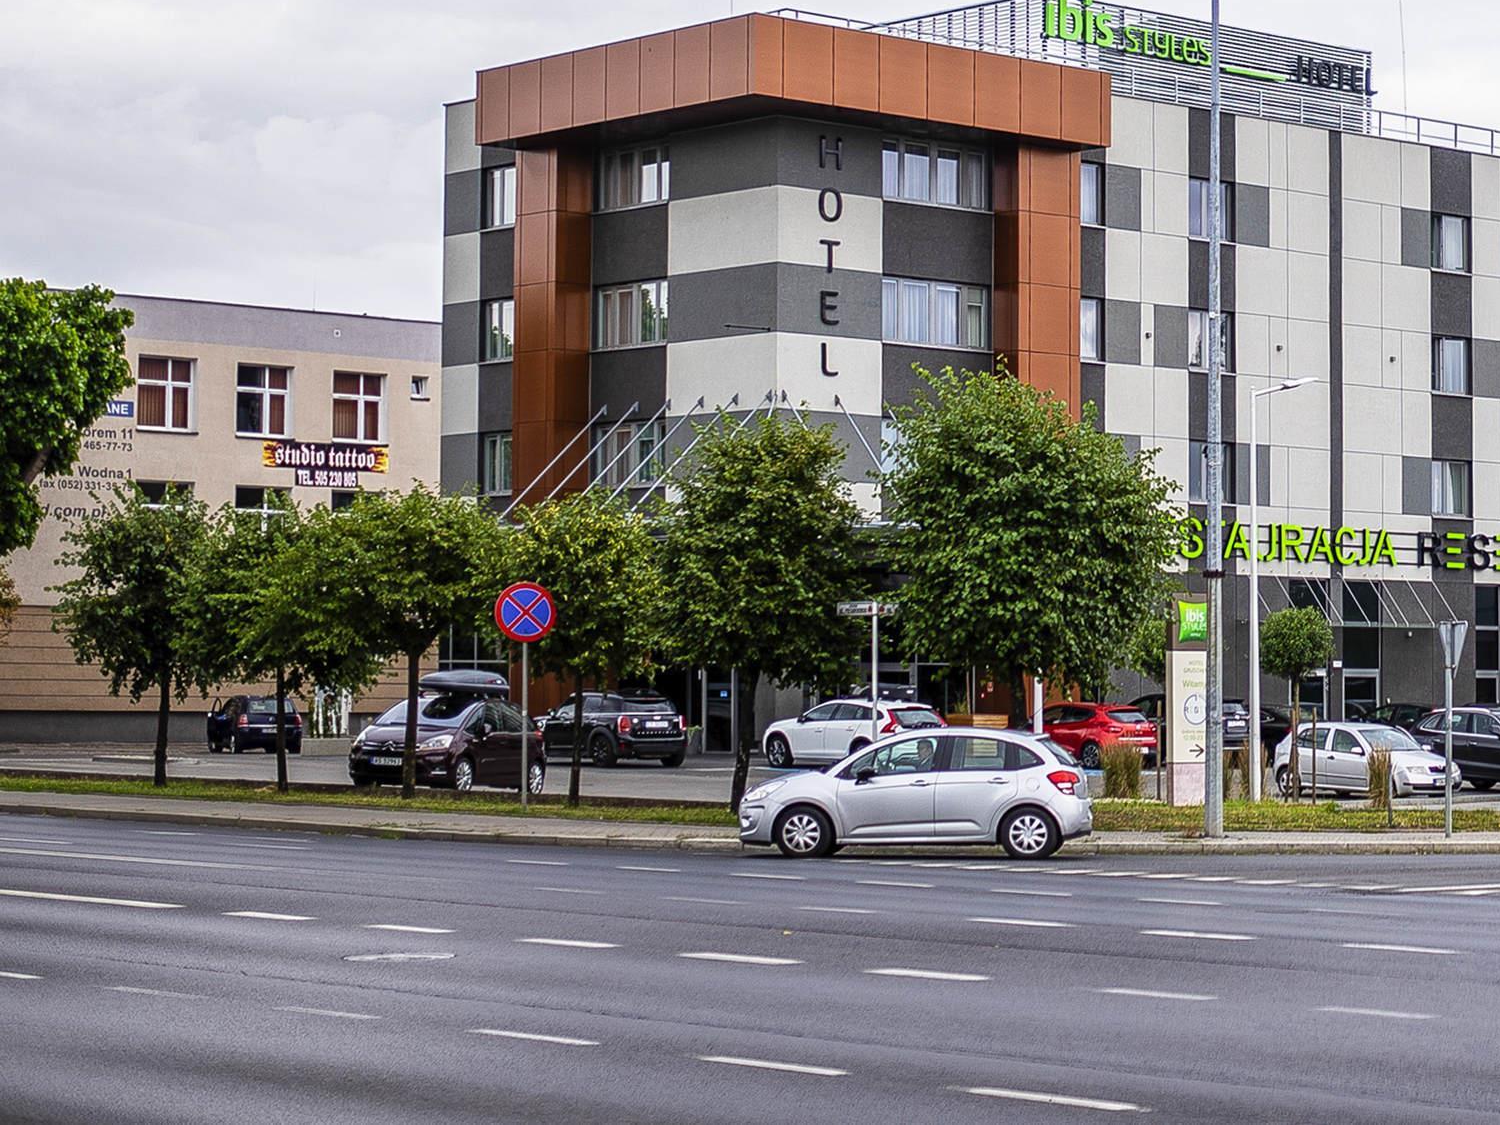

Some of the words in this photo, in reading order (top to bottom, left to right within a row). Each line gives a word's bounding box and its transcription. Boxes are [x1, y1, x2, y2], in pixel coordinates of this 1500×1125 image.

[1297, 55, 1378, 95] HOTEL
[818, 135, 843, 378] HOTEL
[83, 428, 116, 439] orem
[121, 428, 132, 440] 11
[328, 447, 375, 468] tattoo
[78, 466, 123, 479] Wodna
[127, 468, 132, 479] 1
[40, 478, 55, 489] fax
[58, 480, 83, 491] (052)
[1159, 517, 1397, 566] SAURACJA
[1185, 609, 1204, 622] ibis
